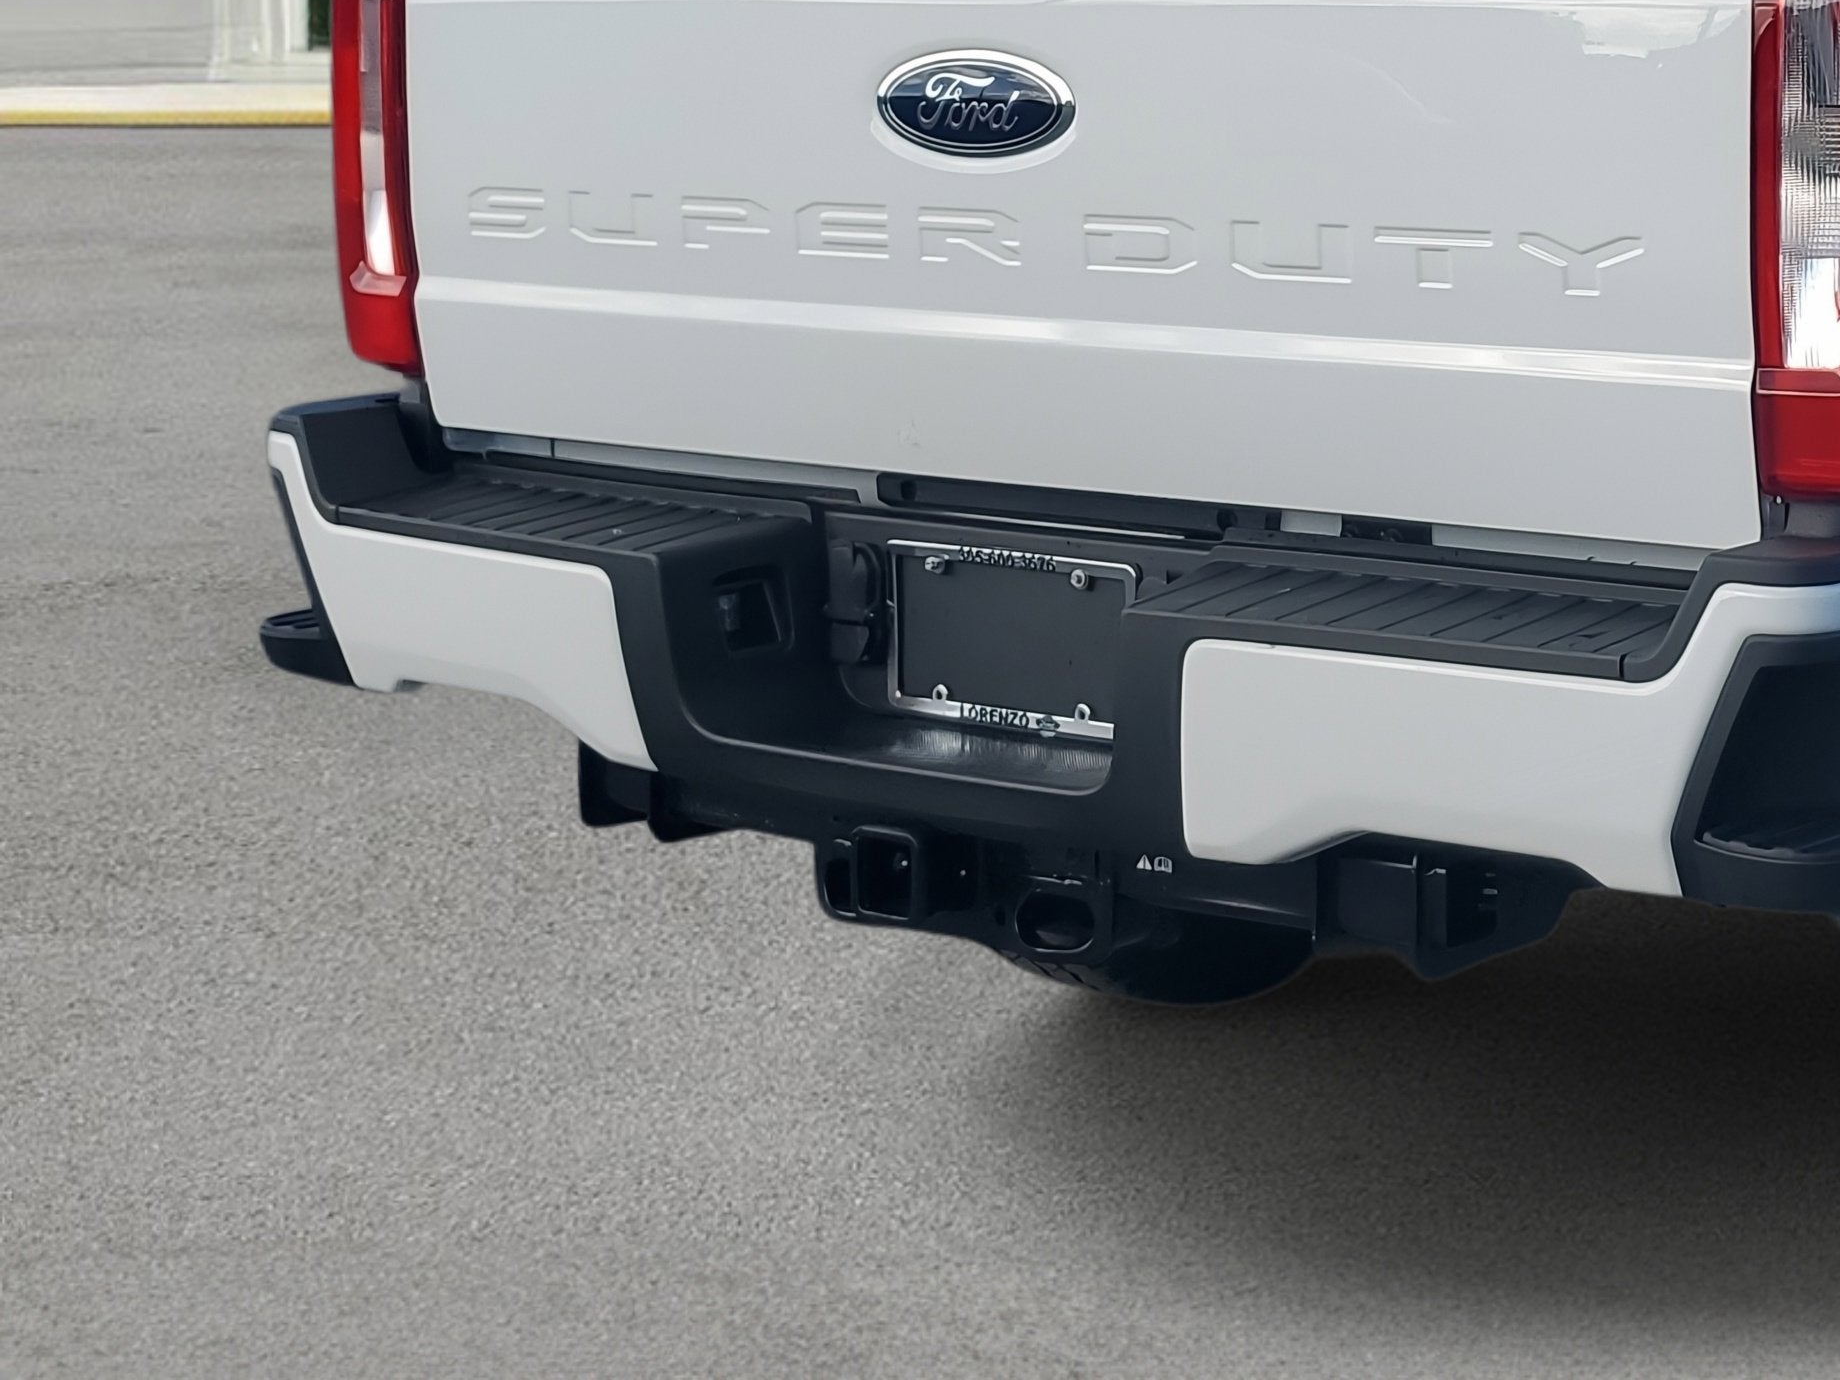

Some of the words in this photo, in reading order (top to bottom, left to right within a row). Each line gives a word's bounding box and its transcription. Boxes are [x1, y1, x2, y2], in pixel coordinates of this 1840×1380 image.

[915, 71, 1020, 134] Ford
[467, 186, 1022, 268] SUPER
[1082, 212, 1645, 296] DUTY
[960, 702, 1030, 729] LORENZO
